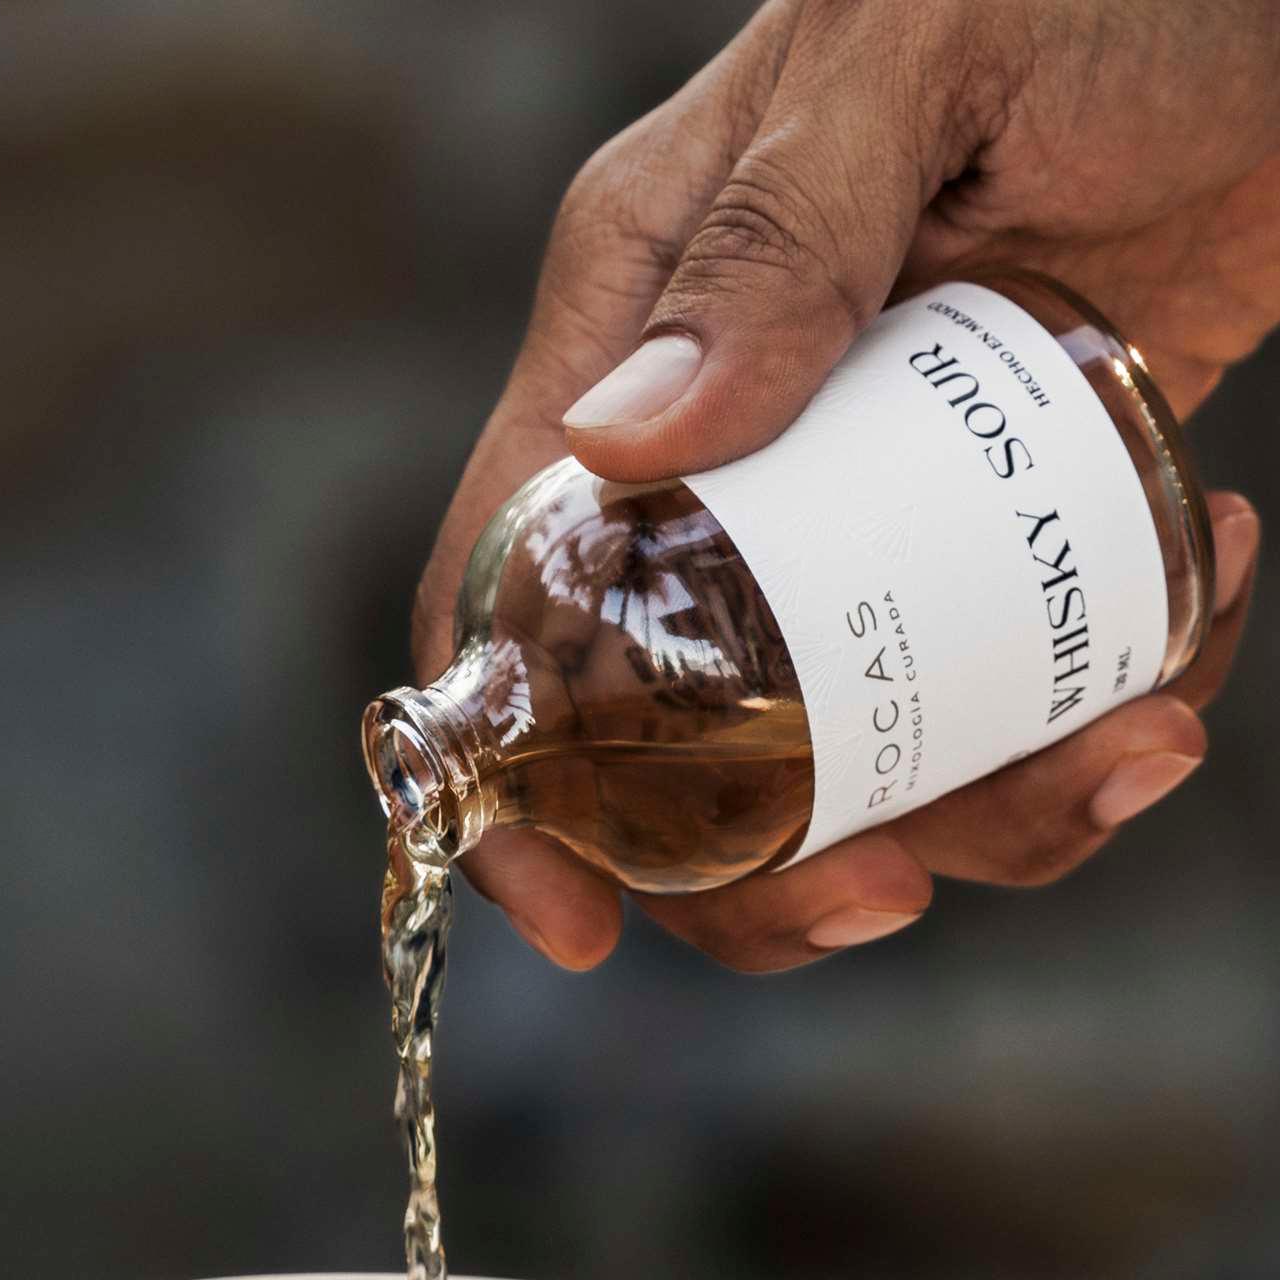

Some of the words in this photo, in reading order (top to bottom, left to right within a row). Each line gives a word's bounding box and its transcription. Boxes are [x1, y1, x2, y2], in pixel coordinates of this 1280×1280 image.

[978, 332, 1003, 350] EN
[999, 351, 1051, 407] HECHO
[909, 342, 1035, 480] SOUR
[884, 590, 916, 681] CURADA
[1015, 508, 1090, 725] WHISKY
[847, 600, 901, 808] ROCAS
